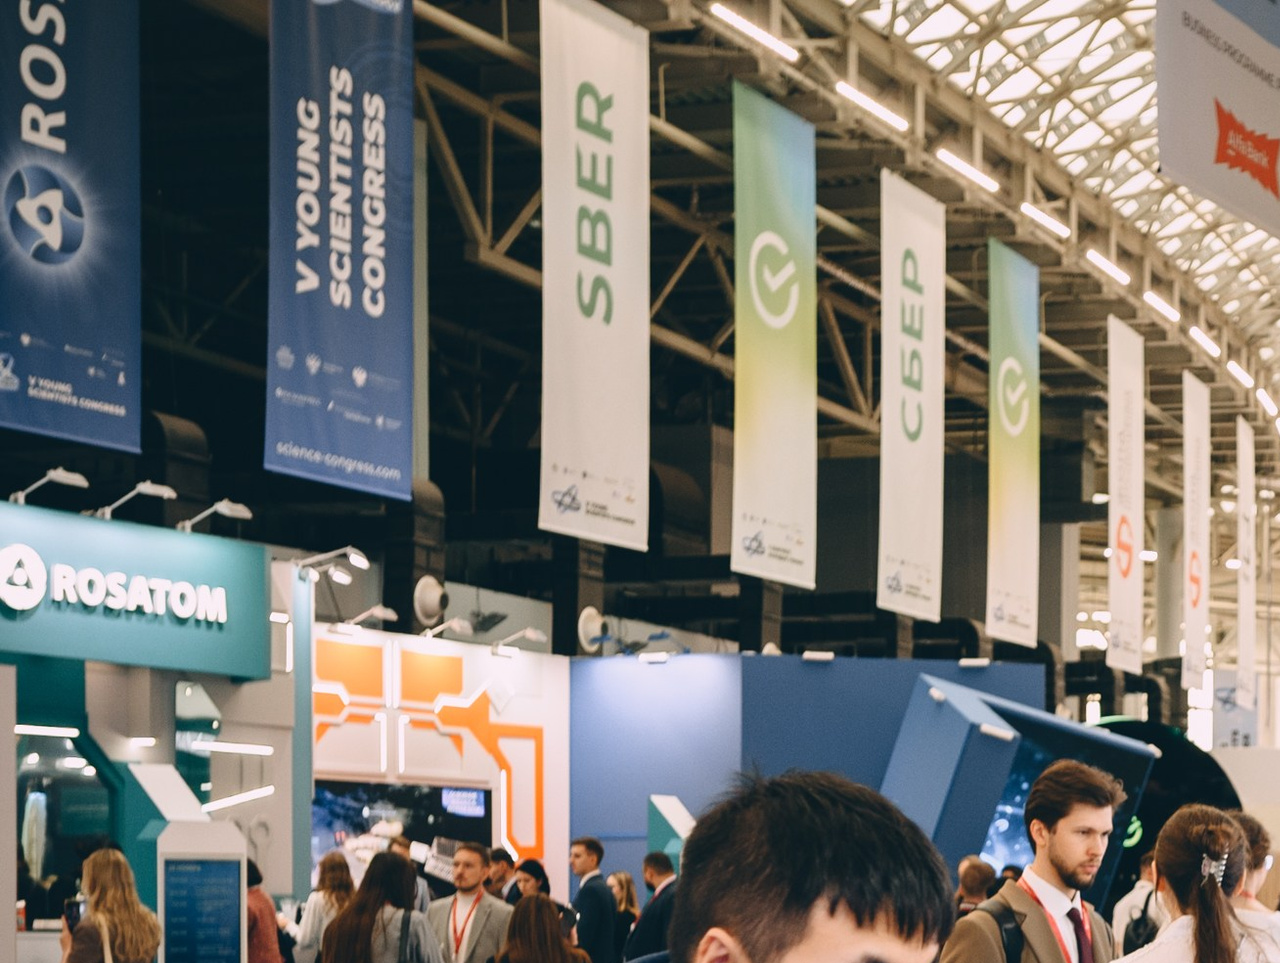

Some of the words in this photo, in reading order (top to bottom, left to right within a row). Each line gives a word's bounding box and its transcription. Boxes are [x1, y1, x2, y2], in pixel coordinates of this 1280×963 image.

[19, 0, 67, 154] ROS
[295, 96, 321, 251] YOUNG
[328, 64, 354, 311] SCIENTISTS
[361, 91, 387, 319] CONGRESS
[576, 80, 614, 327] SBER
[295, 258, 321, 295] V
[901, 248, 924, 442] СБЕР
[53, 562, 229, 625] ROSATOM
